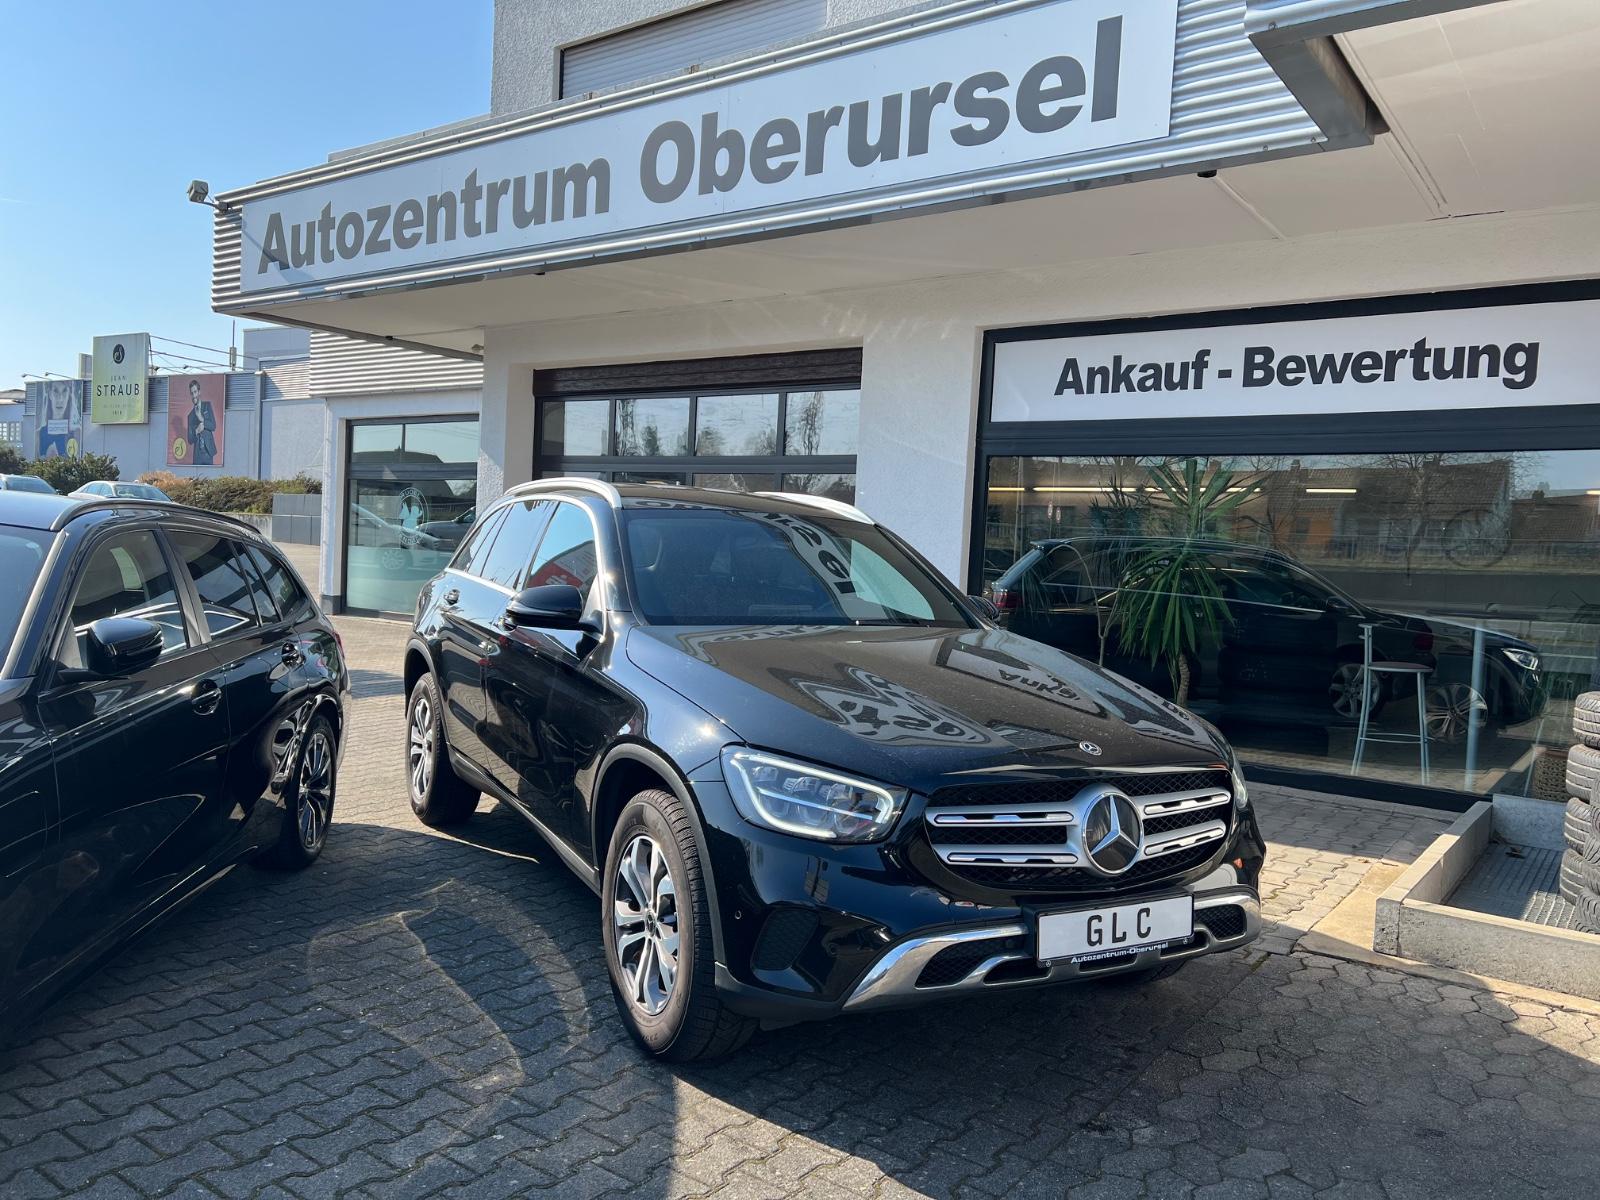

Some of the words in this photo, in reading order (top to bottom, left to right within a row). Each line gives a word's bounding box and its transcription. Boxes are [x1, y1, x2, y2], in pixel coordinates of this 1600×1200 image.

[257, 157, 610, 275] Autozentrum
[640, 15, 1123, 204] Oberursel
[1054, 349, 1211, 396] Ankauf
[1242, 336, 1540, 390] Bewertung
[96, 383, 140, 397] STRAUB
[1070, 942, 1169, 963] Autozentrum-Oberursel
